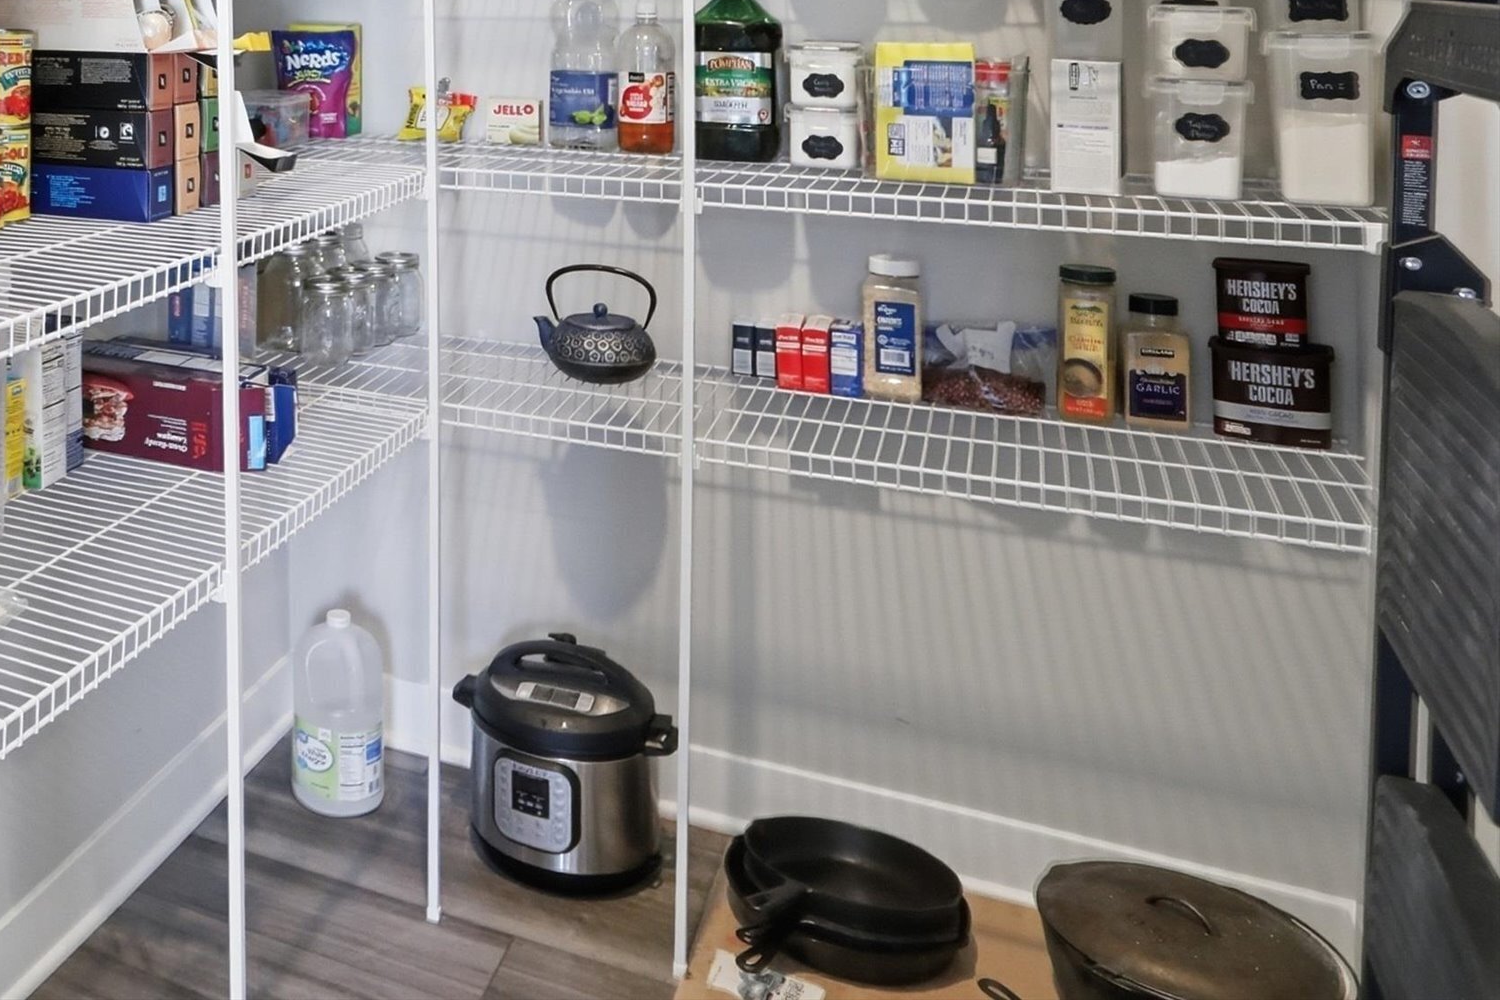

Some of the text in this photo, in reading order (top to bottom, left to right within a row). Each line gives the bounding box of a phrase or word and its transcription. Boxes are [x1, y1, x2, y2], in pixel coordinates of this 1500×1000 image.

[1227, 279, 1297, 300] HERSHEY'S
[1242, 299, 1280, 314] COCOA
[1230, 360, 1315, 389] HERSHEY'S
[1135, 383, 1180, 395] GARLIC
[1249, 385, 1294, 405] COCOA
